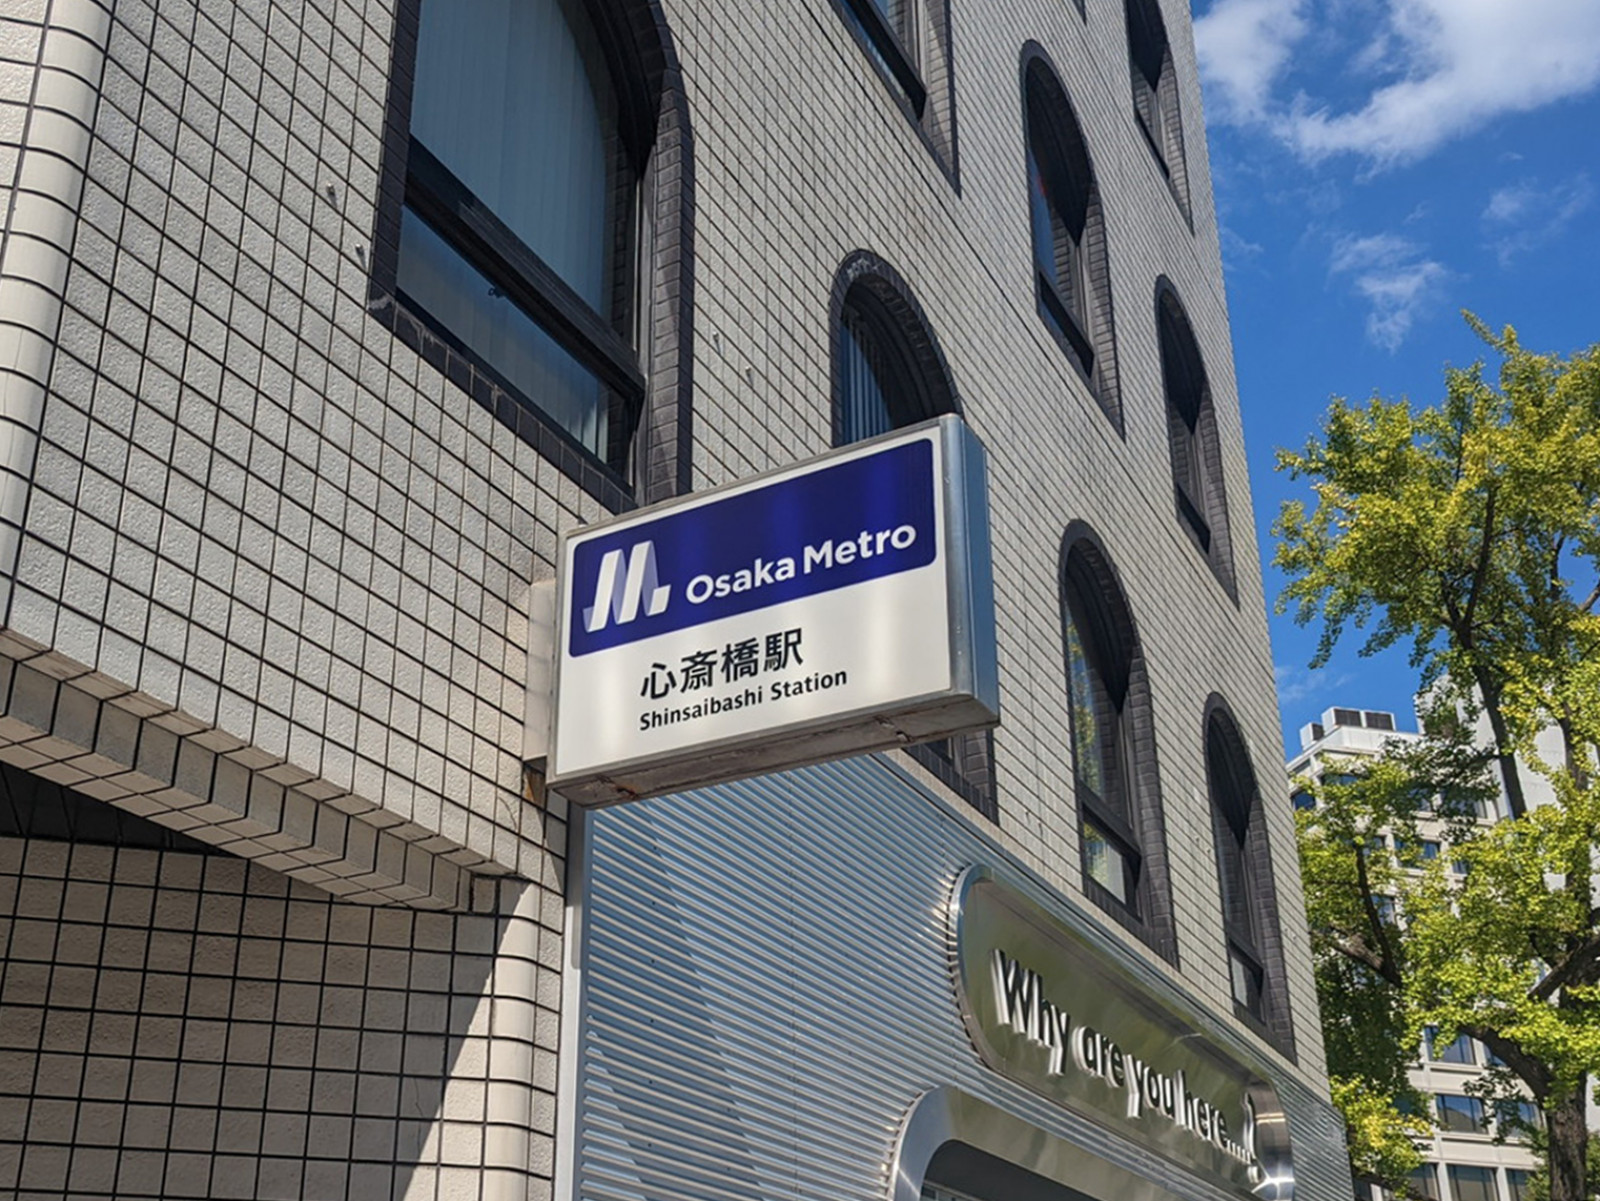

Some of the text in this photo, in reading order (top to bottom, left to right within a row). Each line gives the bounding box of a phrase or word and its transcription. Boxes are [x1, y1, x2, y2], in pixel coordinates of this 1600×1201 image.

[685, 524, 917, 604] Osaka Metro
[640, 627, 804, 700] 心斎橋駅
[640, 670, 847, 731] Shinsaibashi Station
[990, 948, 1071, 1077] Why
[1072, 1025, 1125, 1089] are
[1121, 1053, 1176, 1119] you
